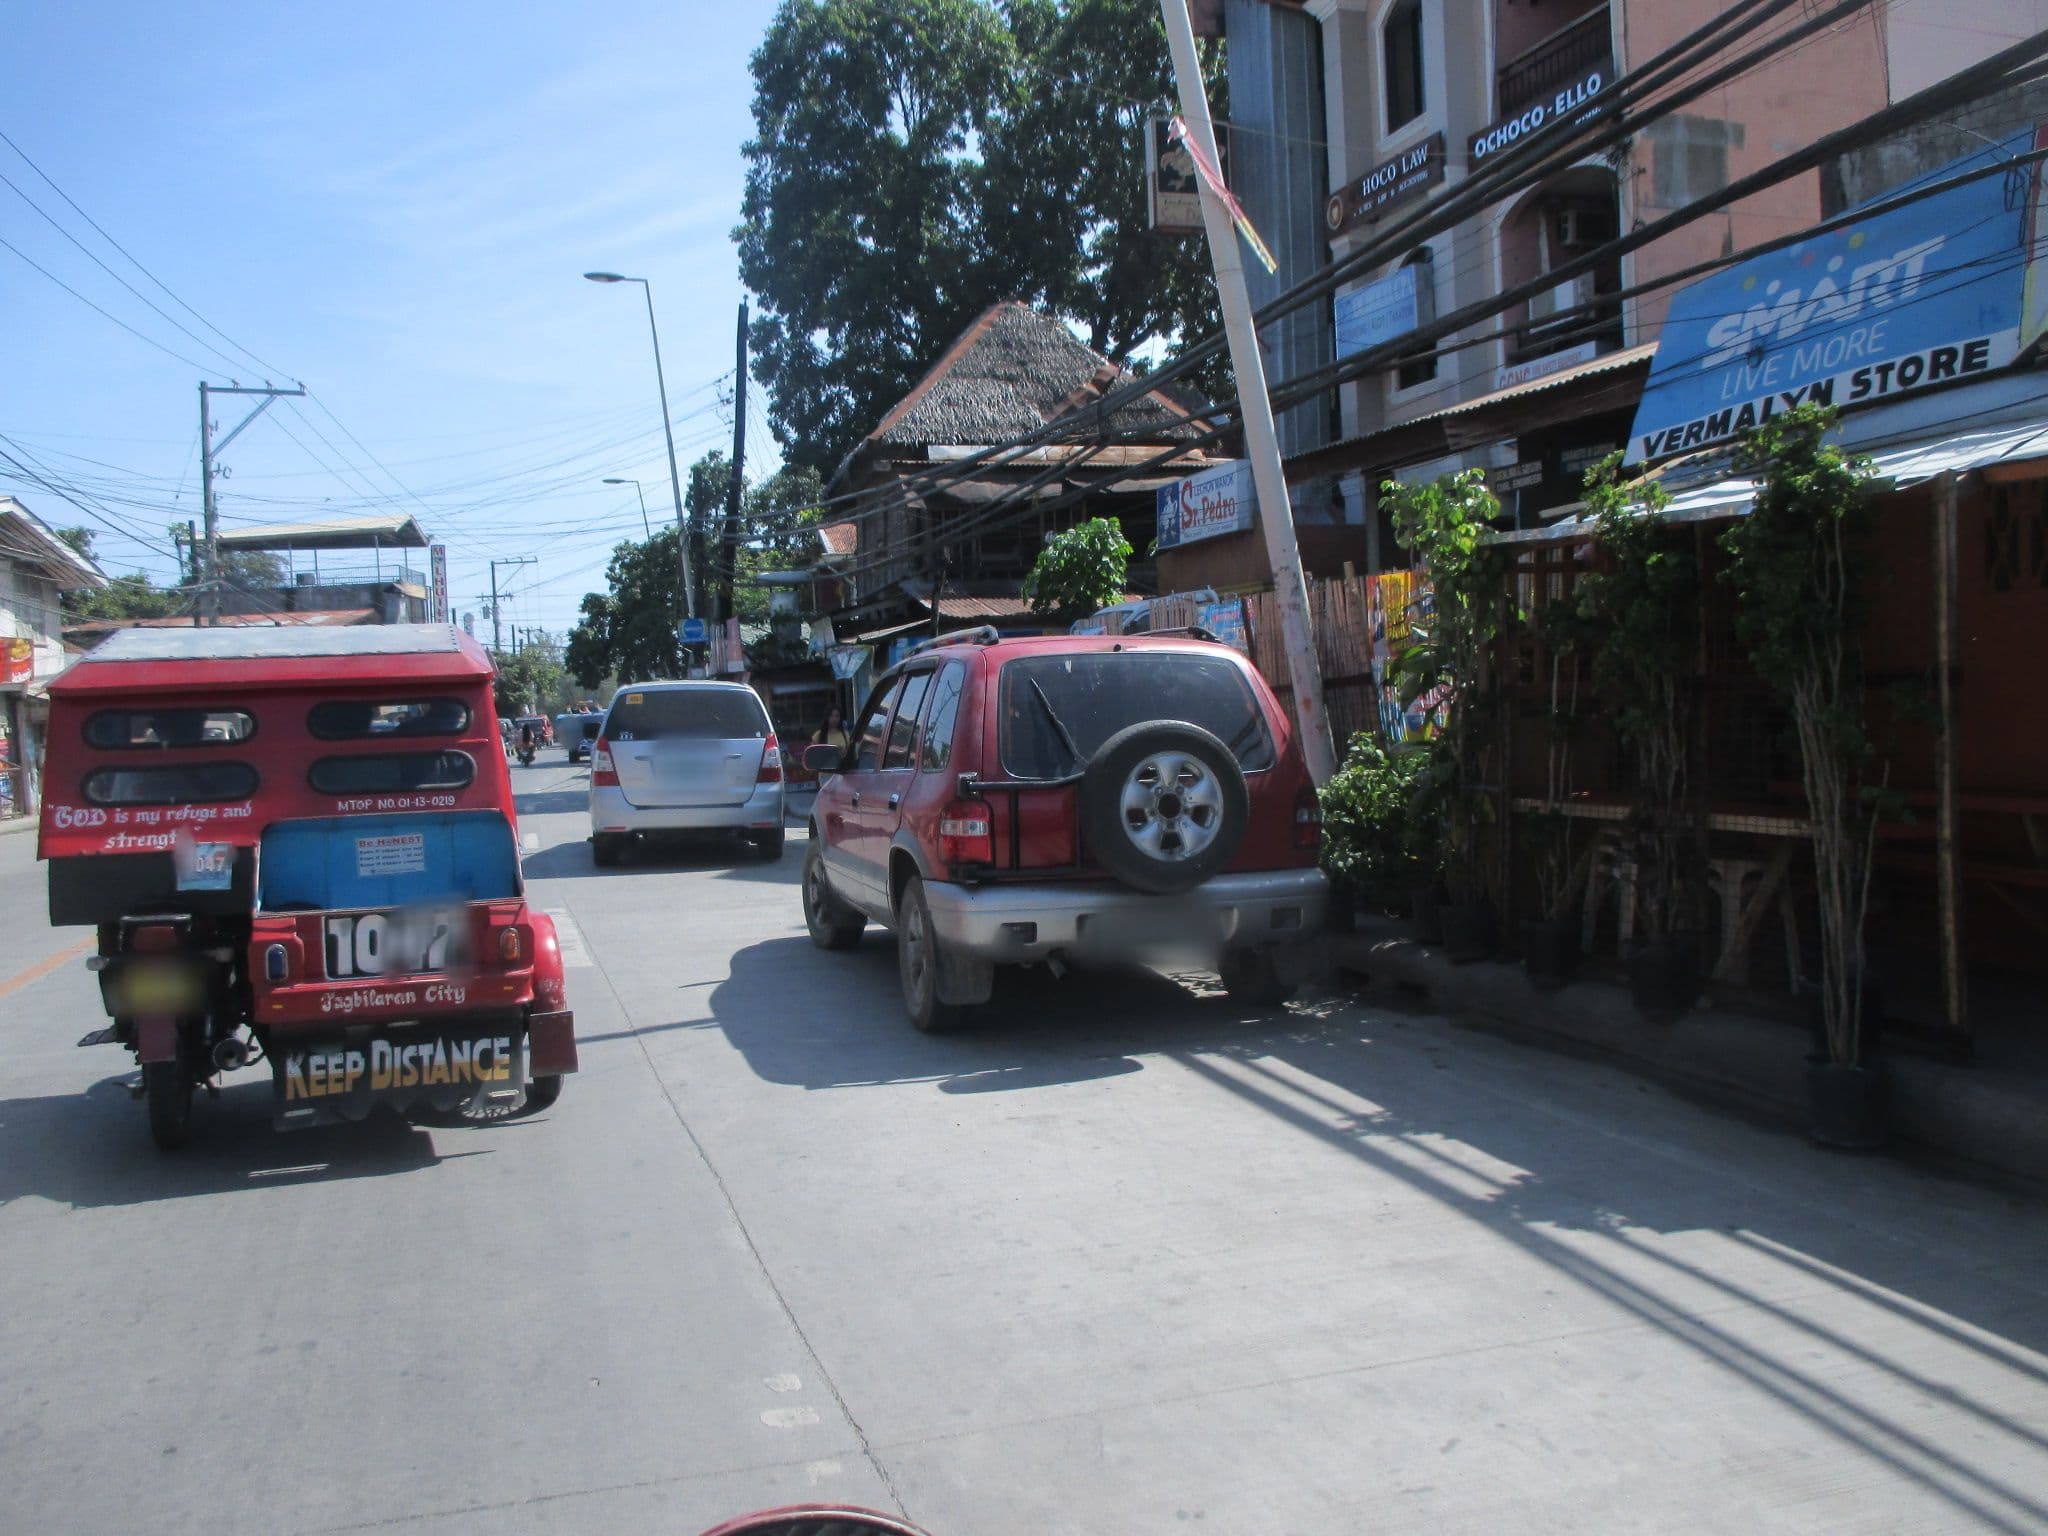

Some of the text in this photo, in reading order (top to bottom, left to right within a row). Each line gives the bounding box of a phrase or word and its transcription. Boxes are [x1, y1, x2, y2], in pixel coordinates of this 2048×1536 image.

[1401, 143, 1428, 174] LAW
[1702, 235, 1946, 369] SMART
[1721, 319, 1889, 400] LIVE MORE
[1643, 380, 1834, 458] VERMALYN
[1848, 339, 1990, 400] STORE
[1202, 491, 1236, 525] Pedro
[115, 807, 129, 824] is
[135, 809, 160, 825] my
[166, 804, 218, 821] refuge
[223, 800, 252, 818] and
[338, 800, 373, 812] MTOP
[321, 985, 466, 1013] Tagbilaran City
[286, 1035, 511, 1101] KEEP DISTANCE
